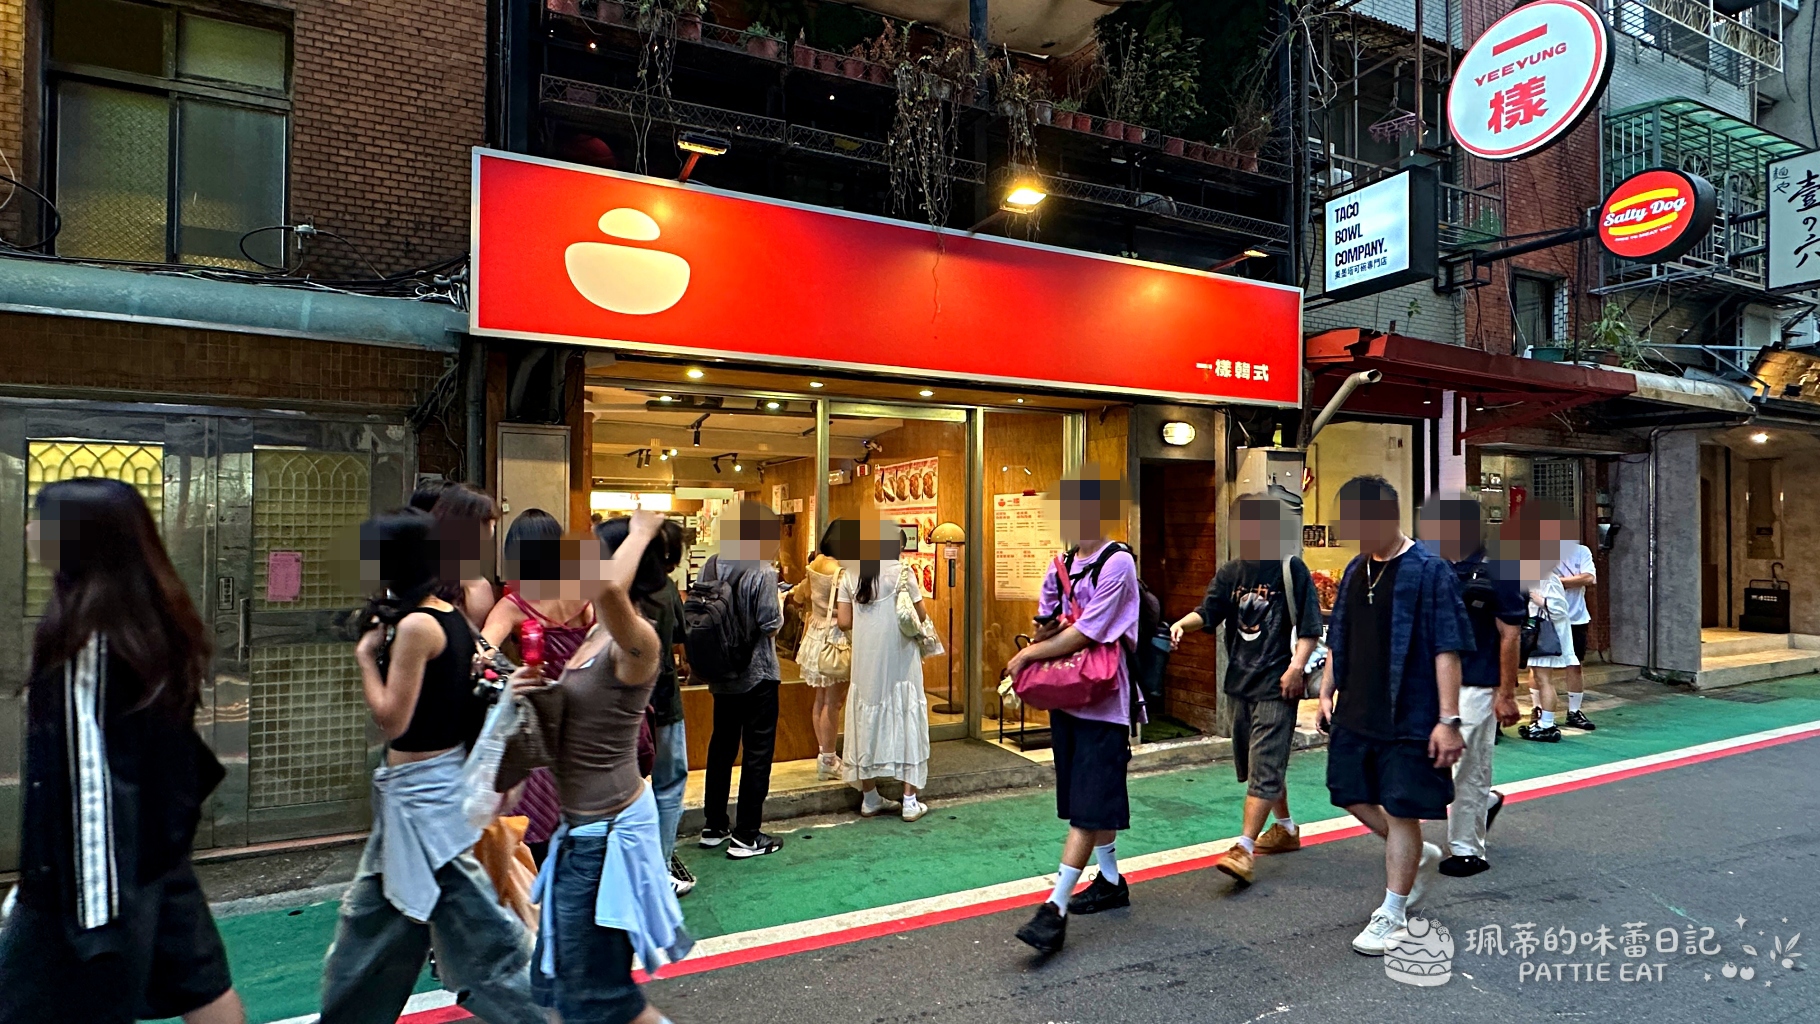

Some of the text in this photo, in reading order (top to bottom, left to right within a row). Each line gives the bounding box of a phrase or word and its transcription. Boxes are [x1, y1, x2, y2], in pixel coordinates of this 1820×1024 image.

[1492, 23, 1548, 57] 一
[1474, 42, 1567, 87] YEEYUNG
[1487, 75, 1549, 134] 樣
[1334, 201, 1359, 223] TACO
[1603, 197, 1687, 227] Salty Dog
[1334, 223, 1363, 246] BOWL
[1334, 237, 1388, 267] COMPANY.
[1195, 358, 1270, 382] 一樣韓式
